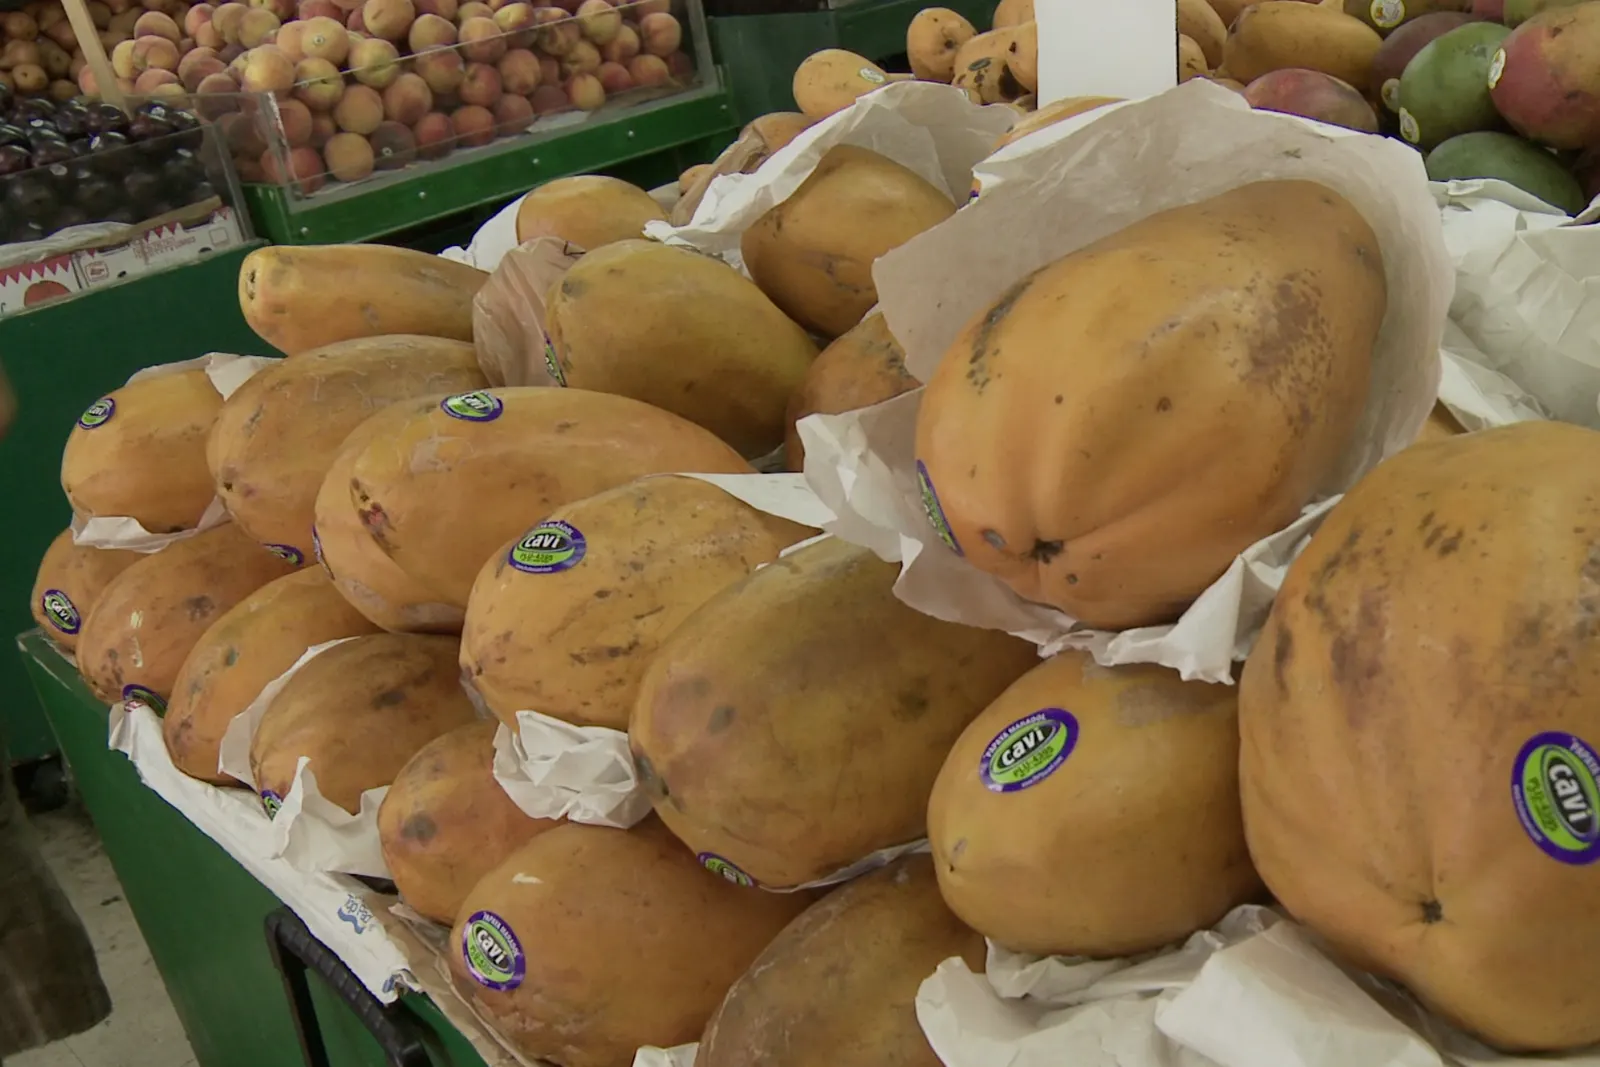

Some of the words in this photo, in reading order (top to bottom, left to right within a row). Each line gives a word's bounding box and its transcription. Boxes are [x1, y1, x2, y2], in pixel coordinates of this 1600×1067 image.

[523, 534, 561, 548] cavi
[983, 732, 1009, 758] PAPAYA
[1008, 713, 1046, 733] MARADOL
[1001, 727, 1045, 766] cavi
[1549, 763, 1593, 822] cavi
[477, 929, 508, 964] cavi
